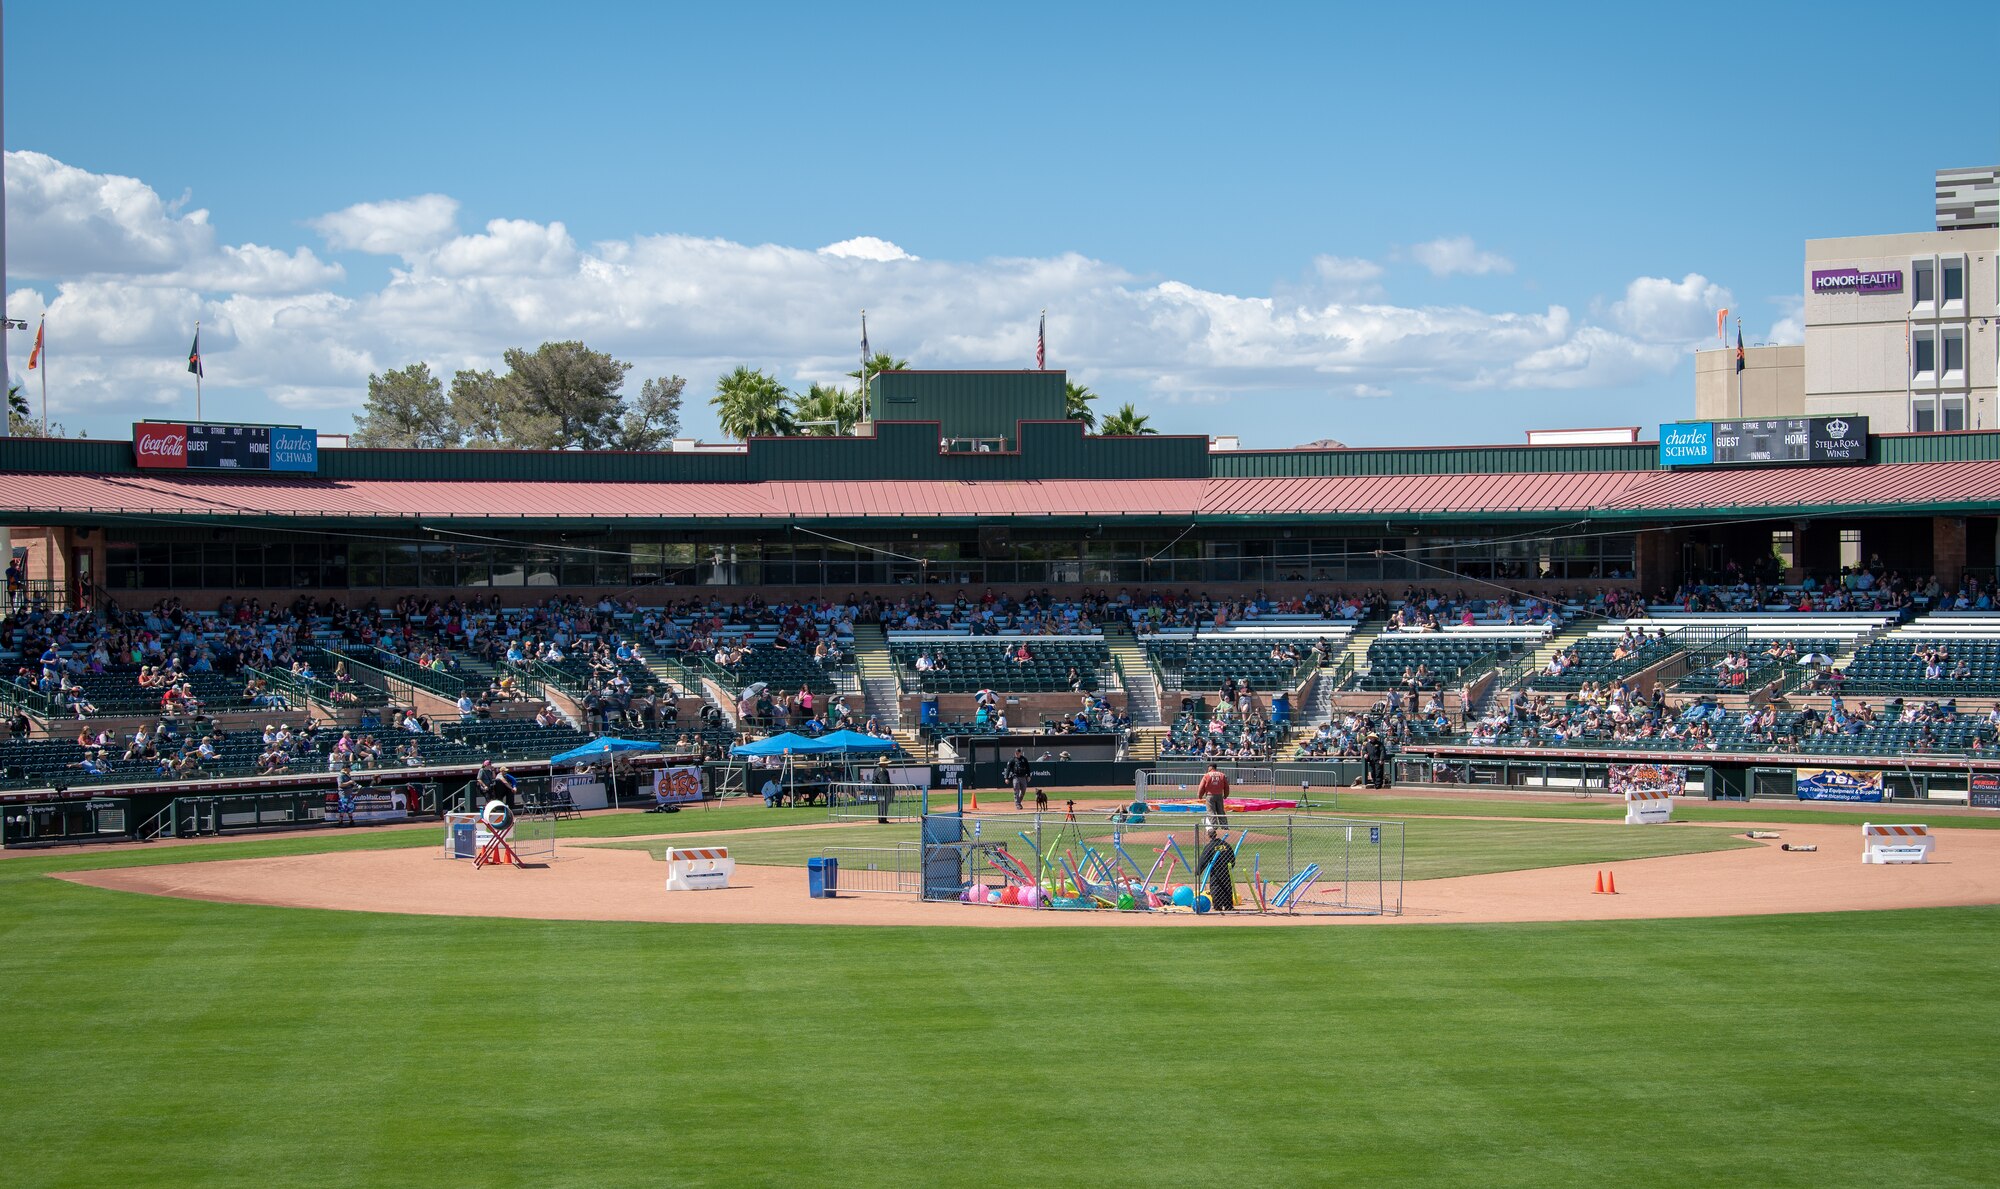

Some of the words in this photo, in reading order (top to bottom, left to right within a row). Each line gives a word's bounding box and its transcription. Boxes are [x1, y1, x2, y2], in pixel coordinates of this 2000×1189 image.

[1816, 273, 1895, 287] HONORHEALTH
[193, 426, 203, 434] BALL
[210, 427, 226, 435] STRIKE
[233, 428, 243, 436] OUT
[1720, 423, 1732, 431] BALL
[1742, 422, 1759, 430] STRIKE
[1766, 421, 1777, 429] OUT
[1788, 420, 1793, 428] H
[1799, 420, 1803, 428] E
[275, 434, 312, 451] charles
[1665, 429, 1707, 446] charles
[1716, 436, 1740, 447] GUEST
[1784, 434, 1808, 445] HOME
[139, 433, 185, 456] Coca-Cola
[187, 440, 209, 452] GUEST
[249, 442, 269, 454] HOME
[1665, 445, 1708, 457] SCHWAB
[1750, 451, 1771, 460] INNING
[219, 458, 237, 468] INNING
[275, 452, 313, 463] SCHWAB
[938, 764, 965, 772] OPENING
[945, 771, 958, 779] DAY
[940, 777, 958, 785] APRIL
[1829, 787, 1854, 795] Equipment
